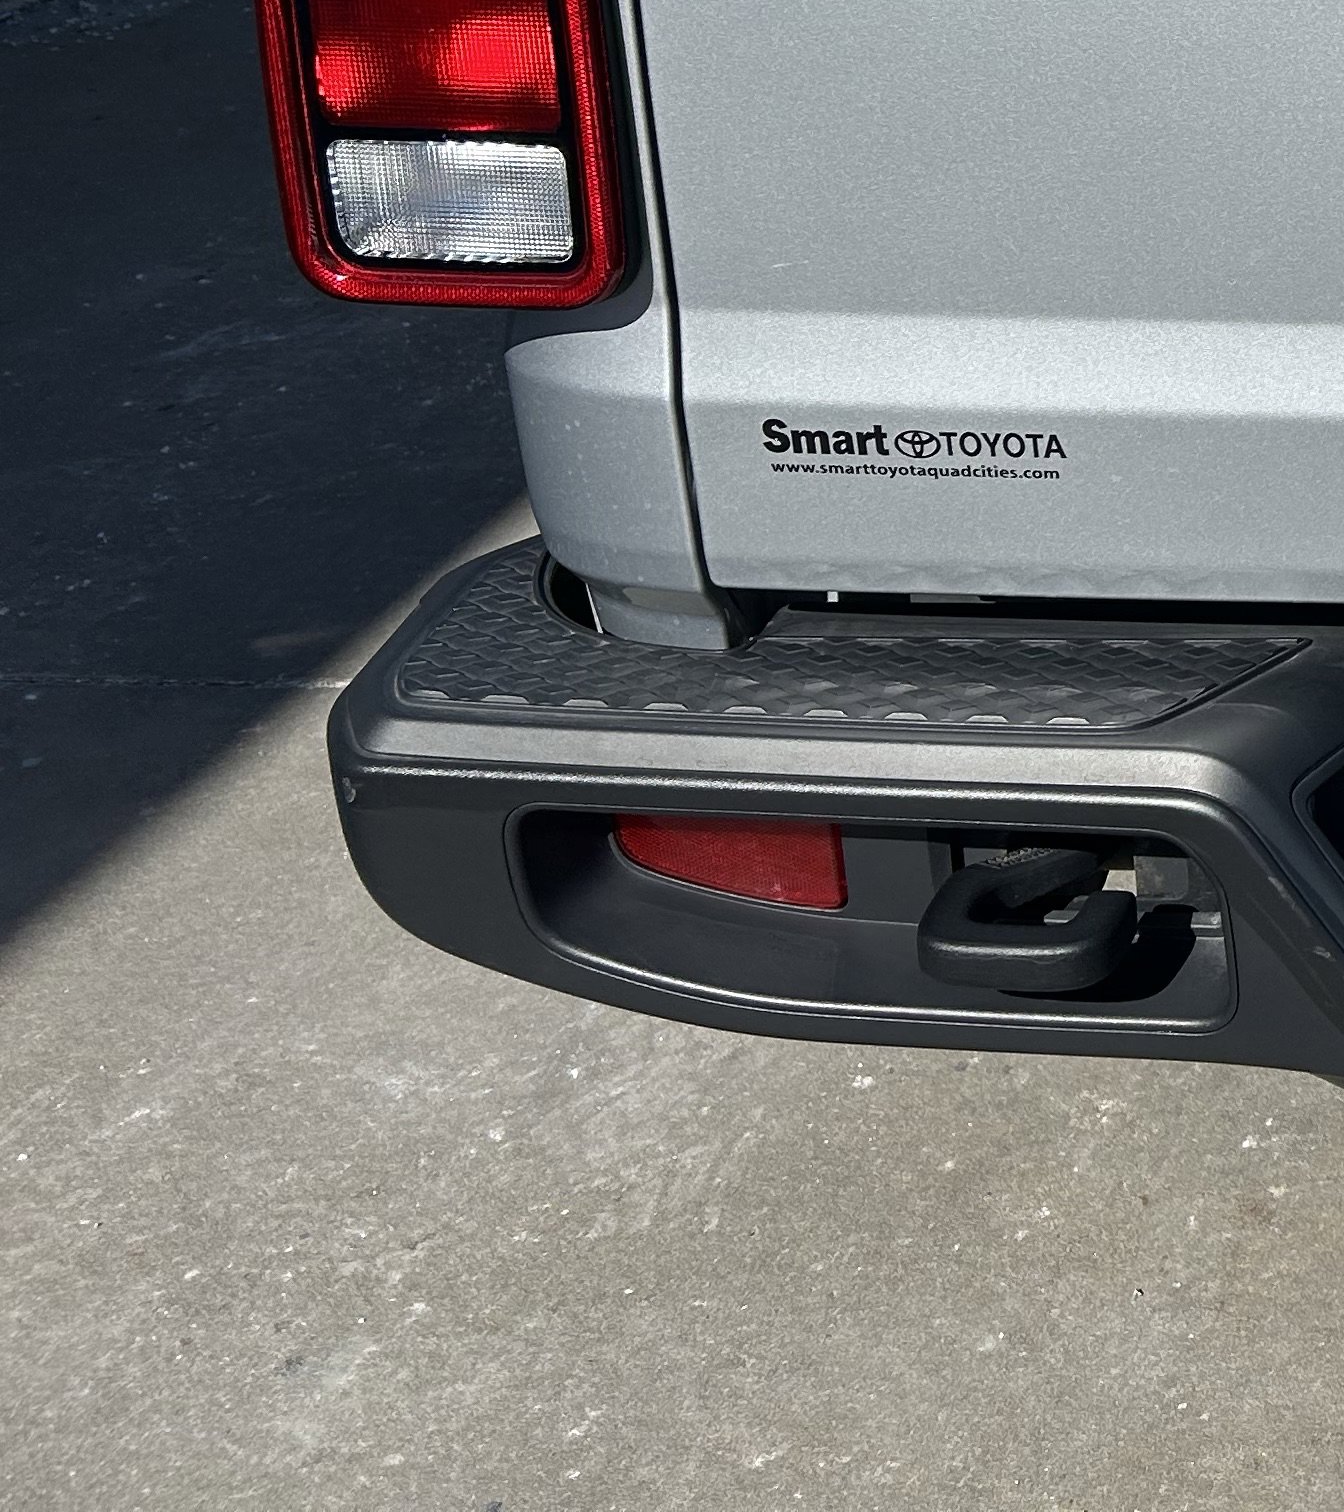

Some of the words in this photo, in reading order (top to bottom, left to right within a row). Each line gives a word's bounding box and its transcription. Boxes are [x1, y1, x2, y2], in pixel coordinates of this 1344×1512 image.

[762, 418, 890, 457] Smart
[938, 431, 1068, 459] TOYOTA
[770, 461, 1061, 481] www.smarttoyotaquadcities.com
